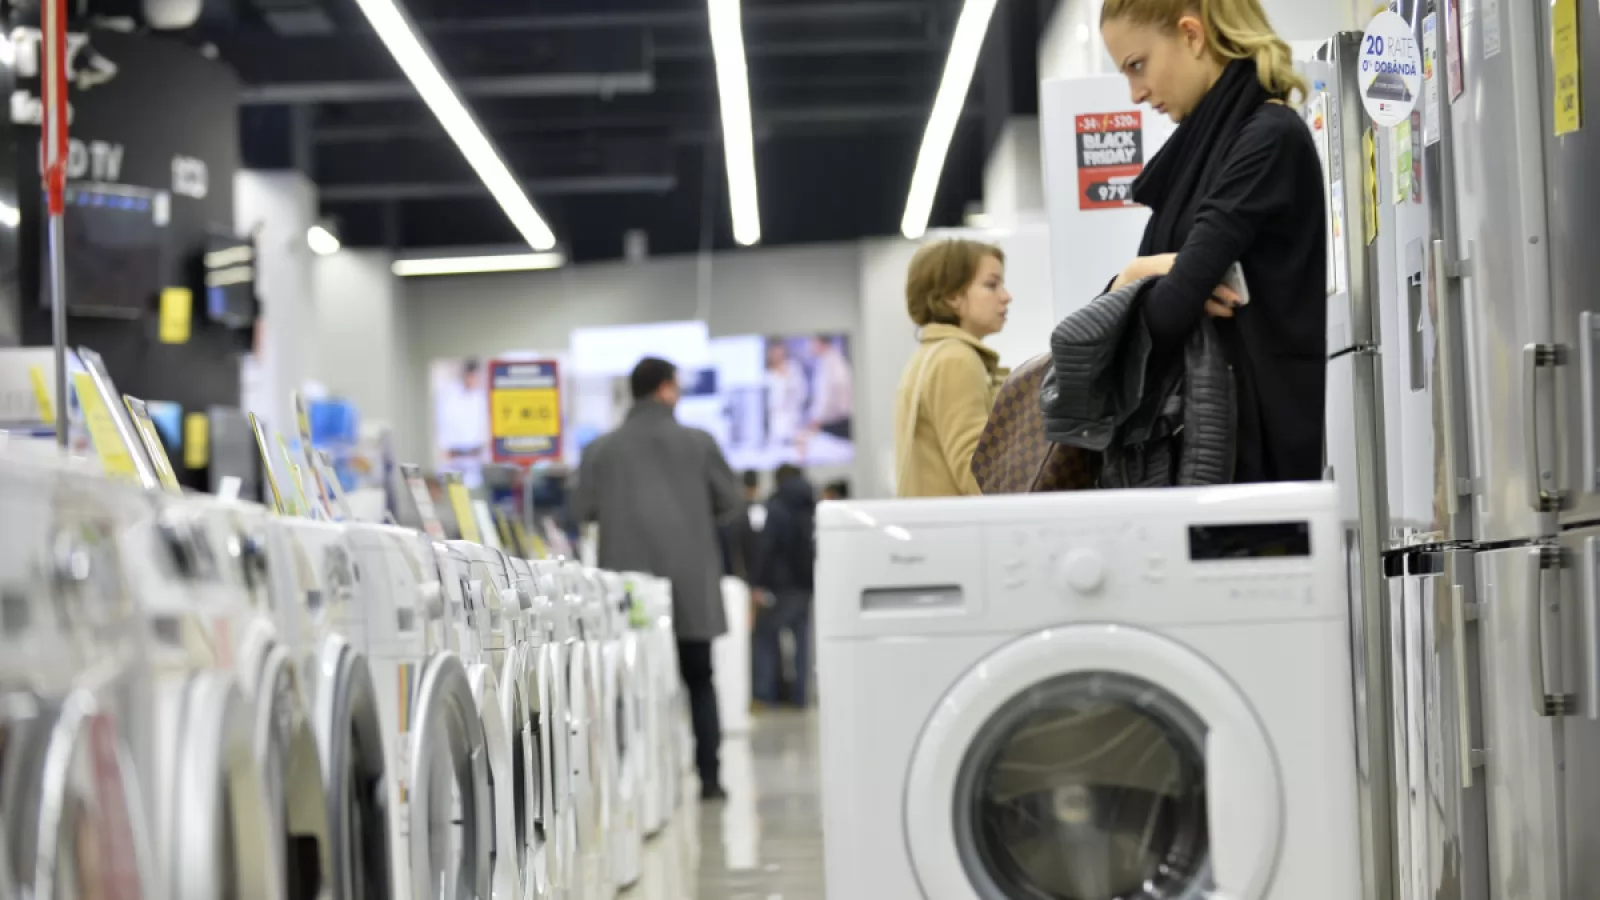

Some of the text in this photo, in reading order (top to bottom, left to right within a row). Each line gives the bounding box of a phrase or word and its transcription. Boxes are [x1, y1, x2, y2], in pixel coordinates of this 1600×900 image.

[1366, 35, 1414, 59] 20 RATE
[1082, 131, 1136, 149] BLACK
[90, 140, 124, 181] TV
[1083, 148, 1136, 166] FRIDAY
